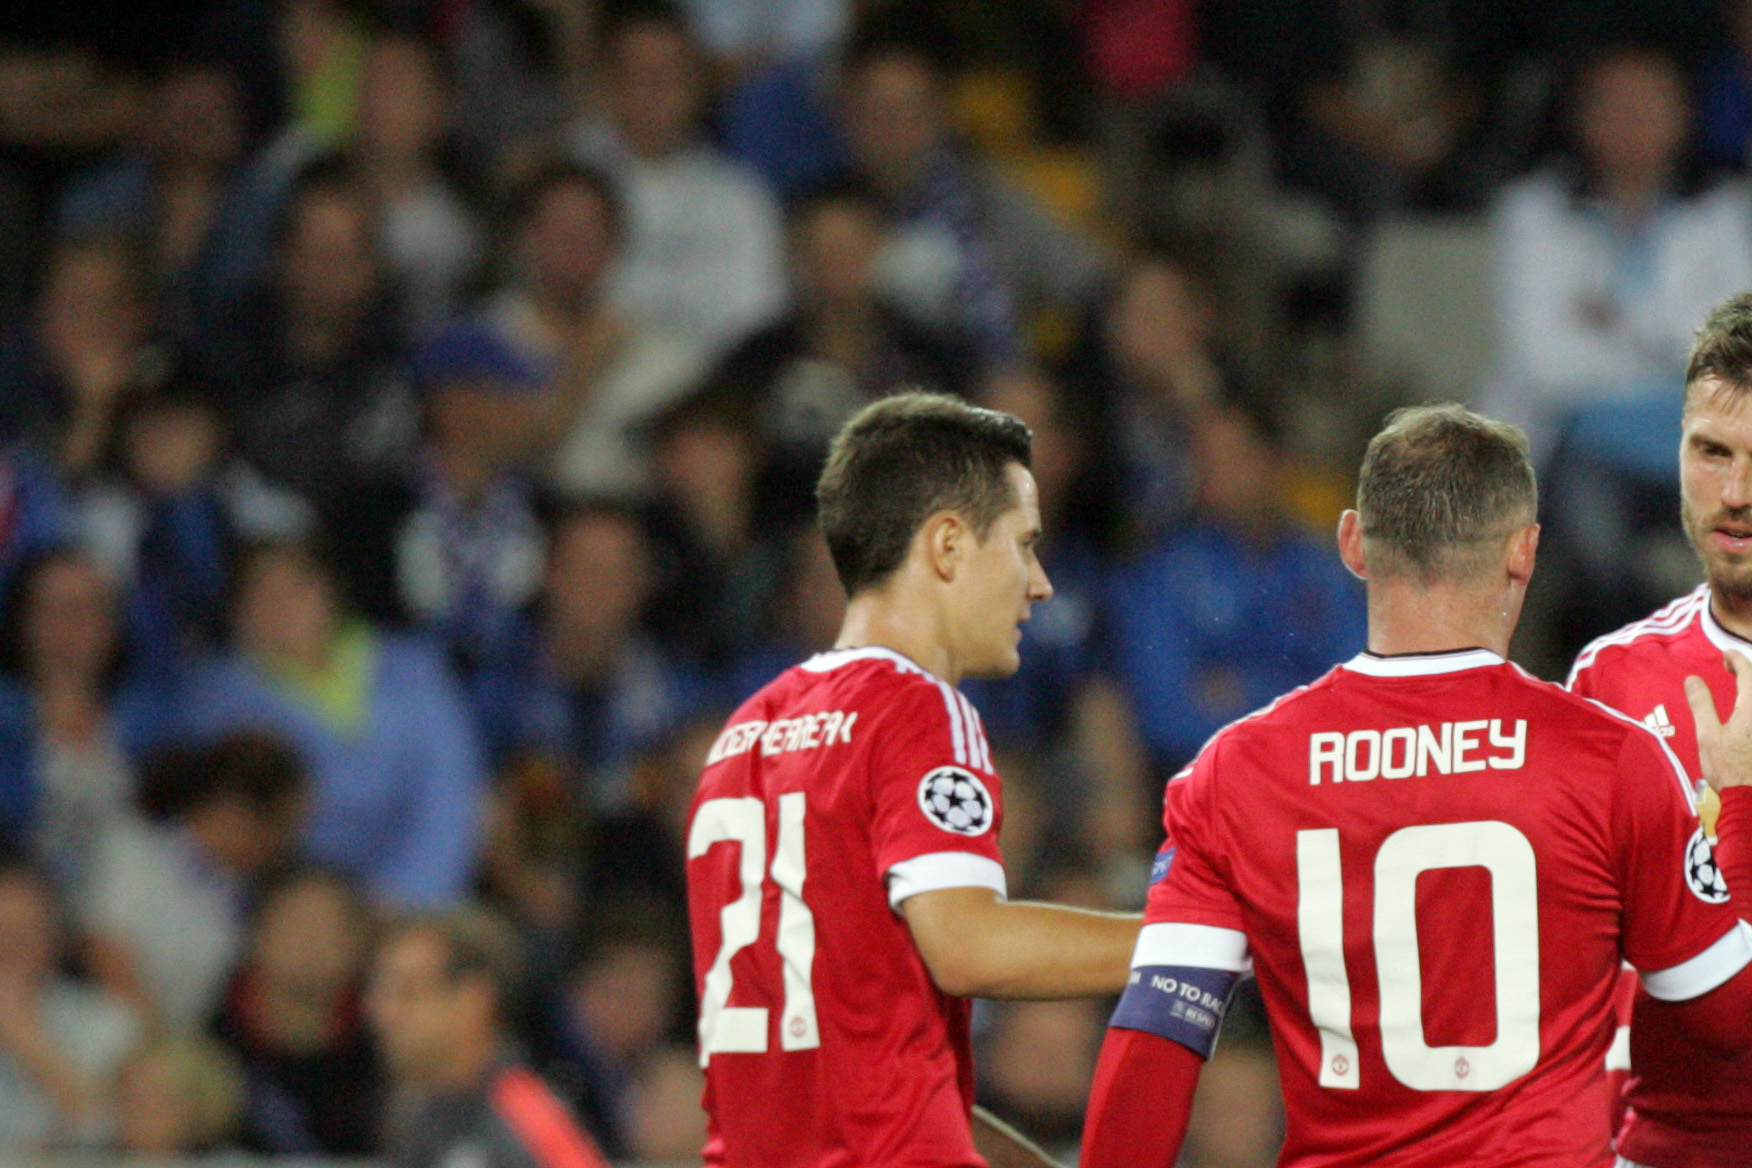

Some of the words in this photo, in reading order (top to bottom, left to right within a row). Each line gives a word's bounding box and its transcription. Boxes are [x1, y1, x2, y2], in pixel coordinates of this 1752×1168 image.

[1309, 718, 1528, 786] ROONEY
[688, 791, 821, 1069] 21
[1151, 975, 1178, 994] NO
[1180, 982, 1201, 1002] TO
[1296, 819, 1541, 1092] 10
